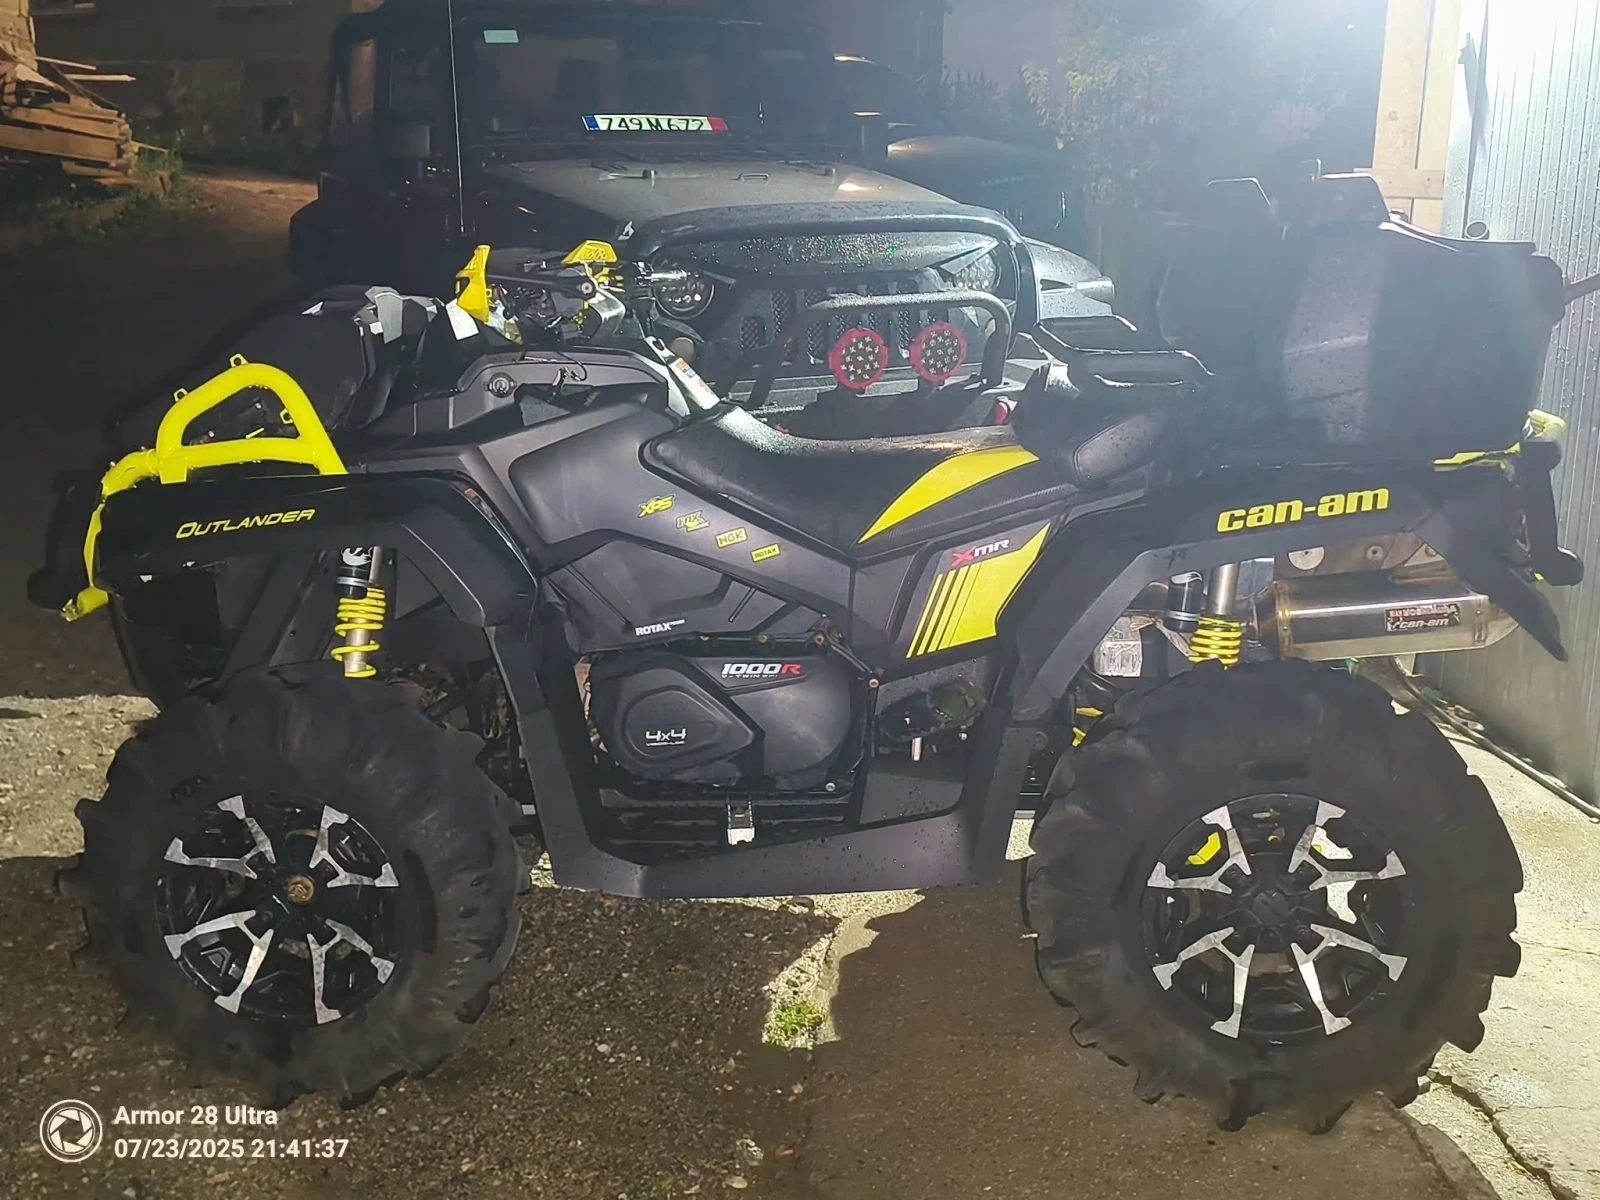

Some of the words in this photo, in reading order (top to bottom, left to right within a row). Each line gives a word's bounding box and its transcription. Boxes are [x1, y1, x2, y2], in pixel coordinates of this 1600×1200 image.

[638, 494, 675, 518] XPS
[1217, 488, 1389, 532] can-am
[175, 508, 316, 539] OUTLANDER
[718, 530, 744, 546] NGK
[754, 547, 777, 559] ROTAX
[635, 621, 672, 637] ROTAX
[1399, 618, 1450, 629] can-am
[721, 663, 801, 676] 1000R
[645, 728, 687, 741] 4x4
